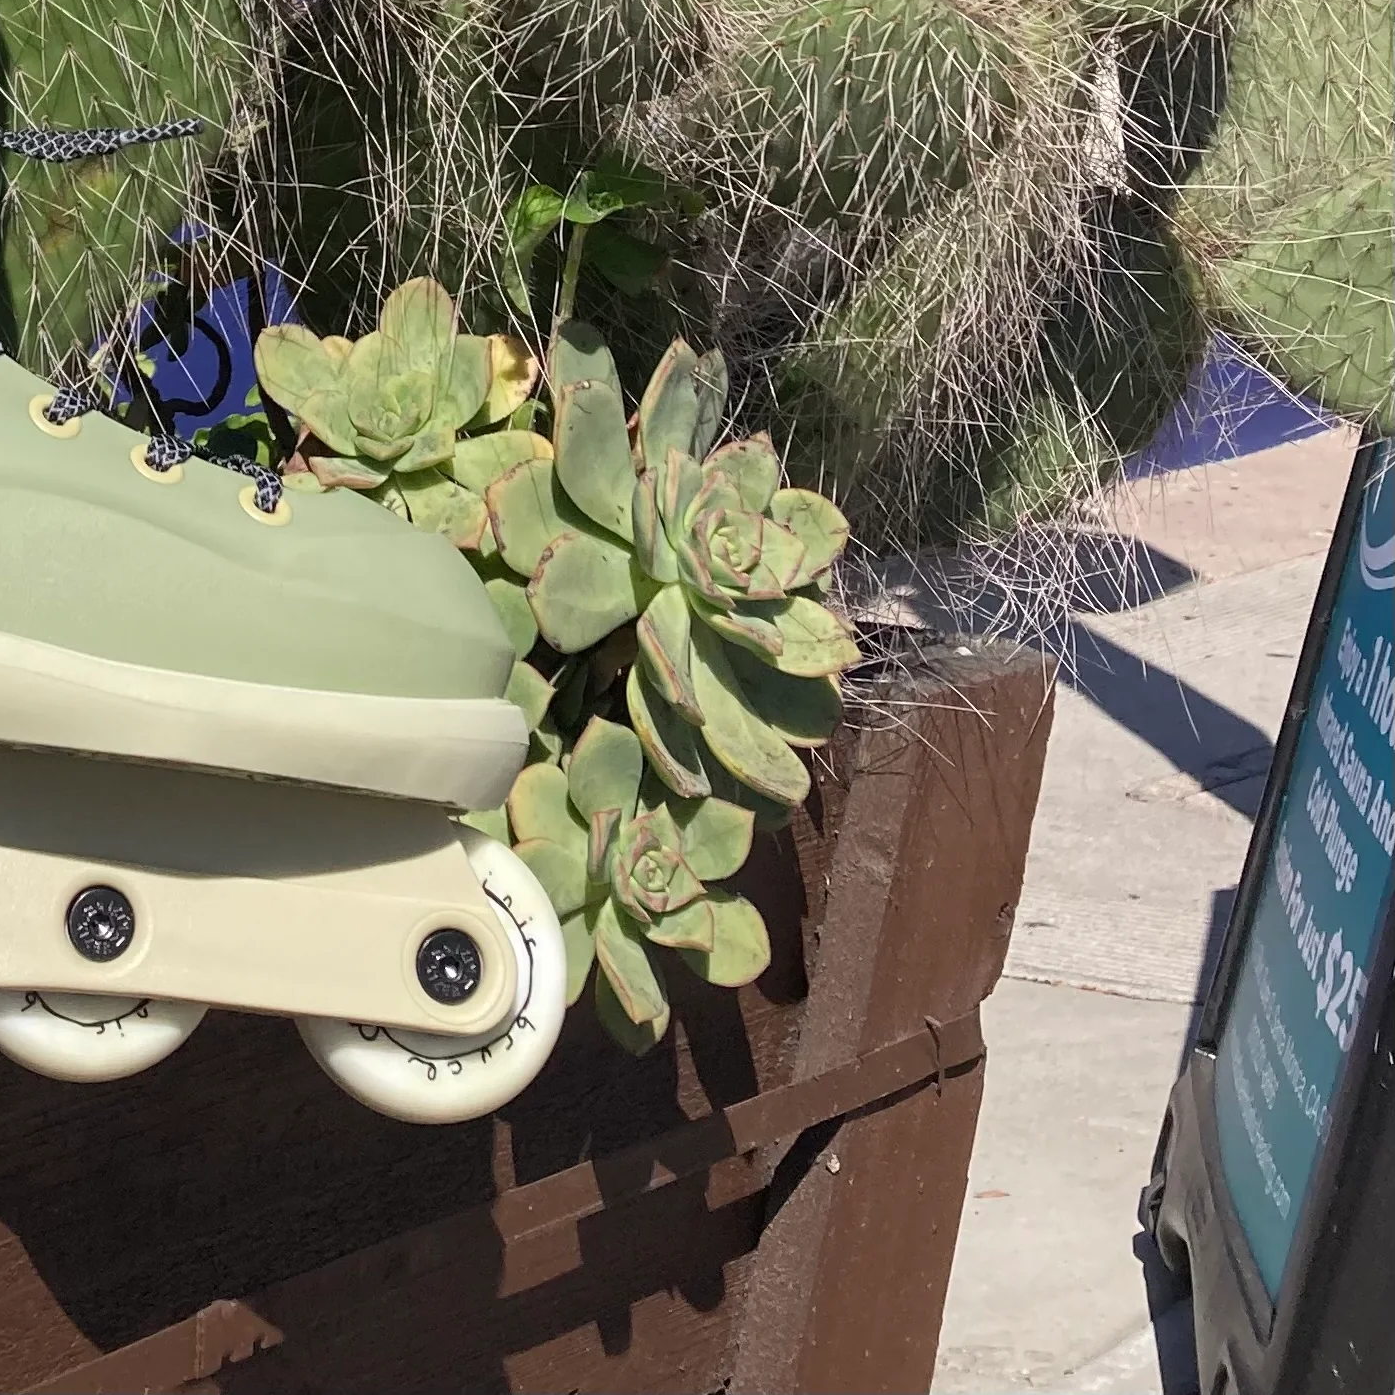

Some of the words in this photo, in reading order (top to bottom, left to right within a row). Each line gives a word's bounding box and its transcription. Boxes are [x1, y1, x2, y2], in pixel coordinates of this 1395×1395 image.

[1306, 766, 1333, 837] Cold
[1320, 798, 1359, 893] Plunge
[1315, 926, 1370, 1053] $25
